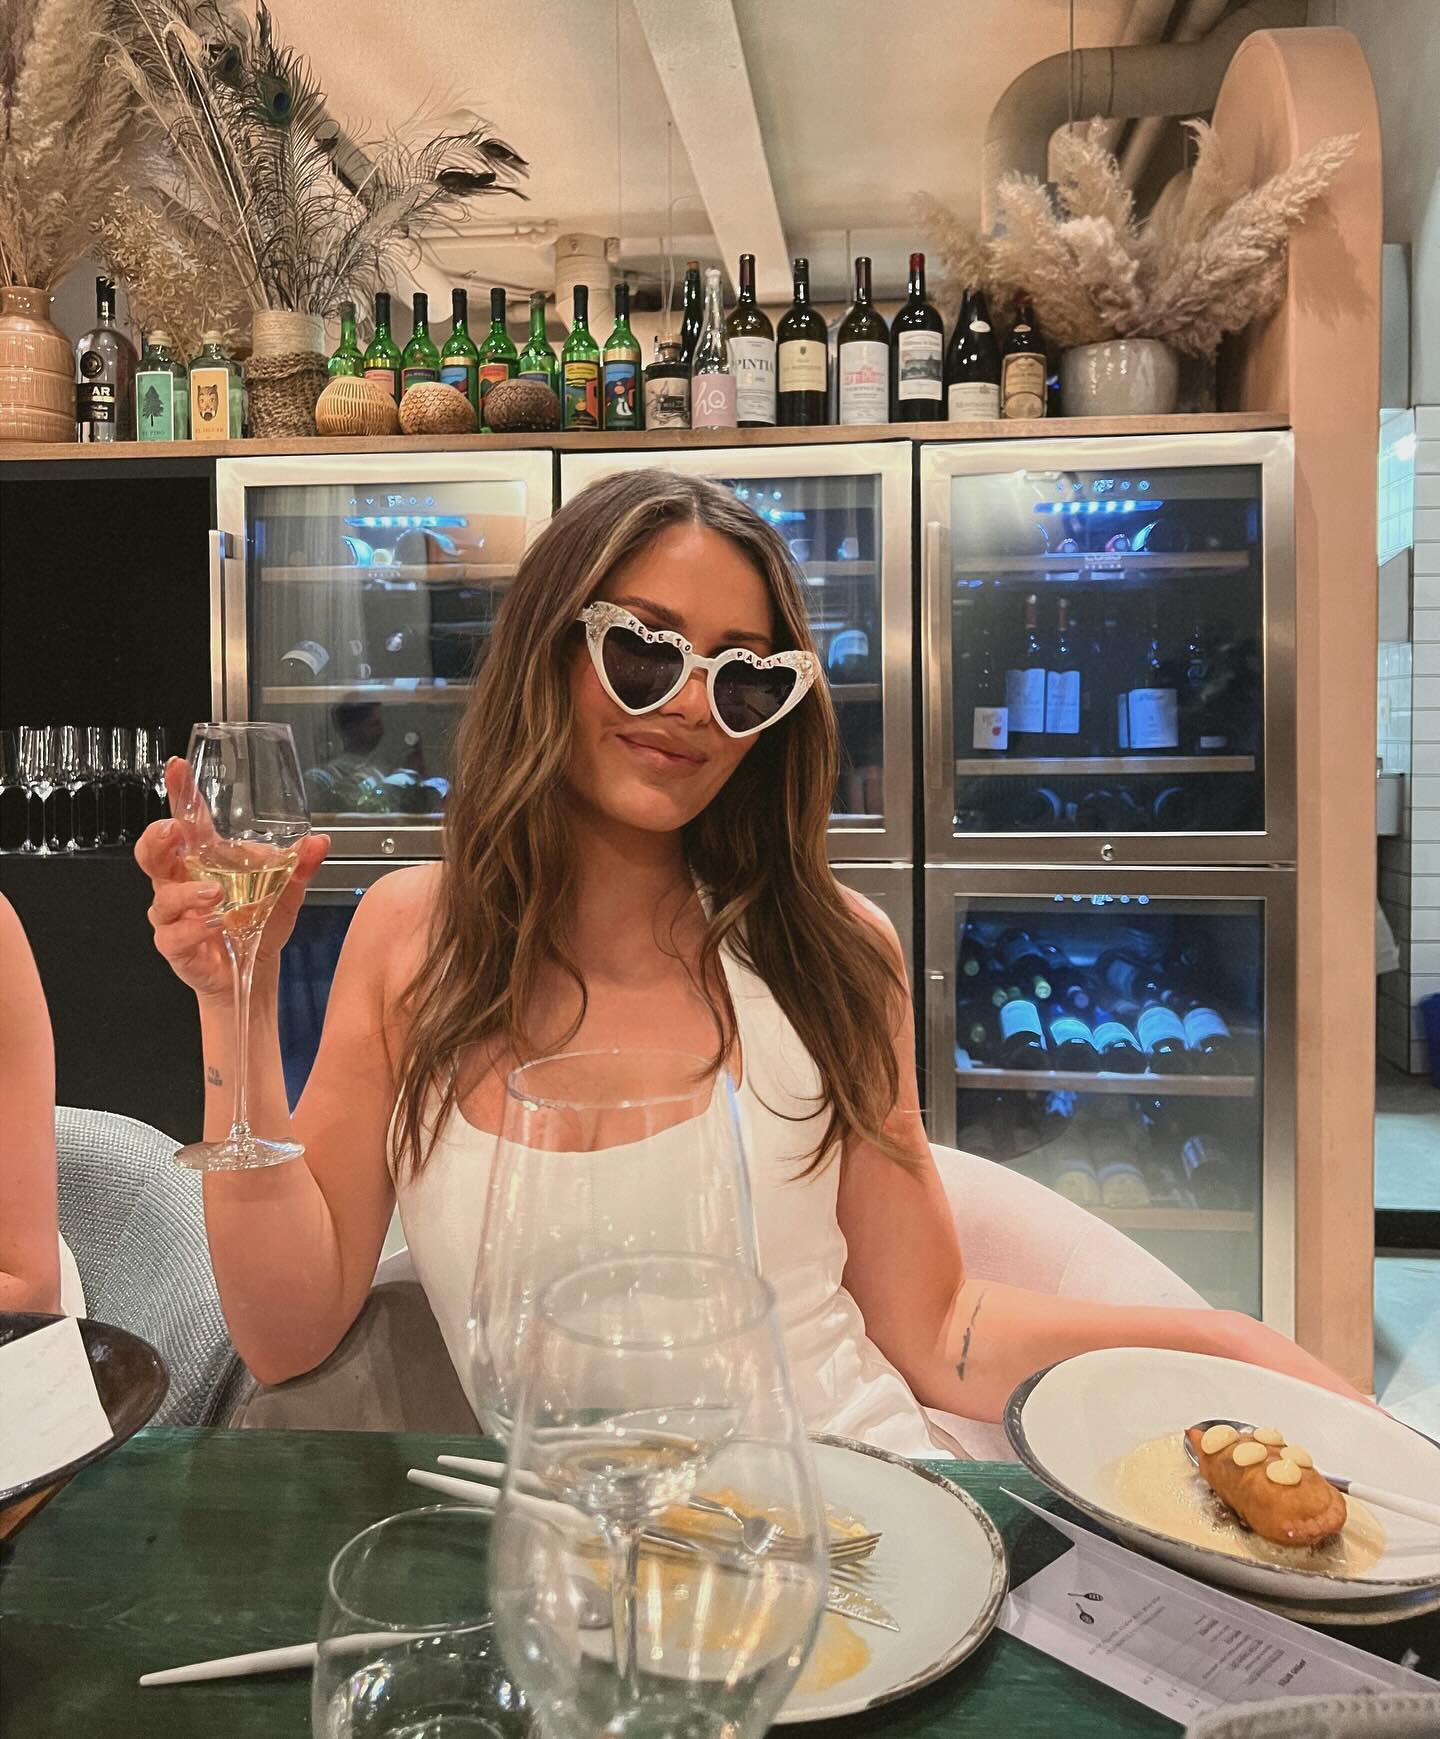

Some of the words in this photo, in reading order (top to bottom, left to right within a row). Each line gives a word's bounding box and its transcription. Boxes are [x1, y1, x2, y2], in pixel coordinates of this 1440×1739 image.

[628, 619, 664, 642] HERE
[675, 638, 691, 651] TO
[737, 651, 783, 667] PARTY
